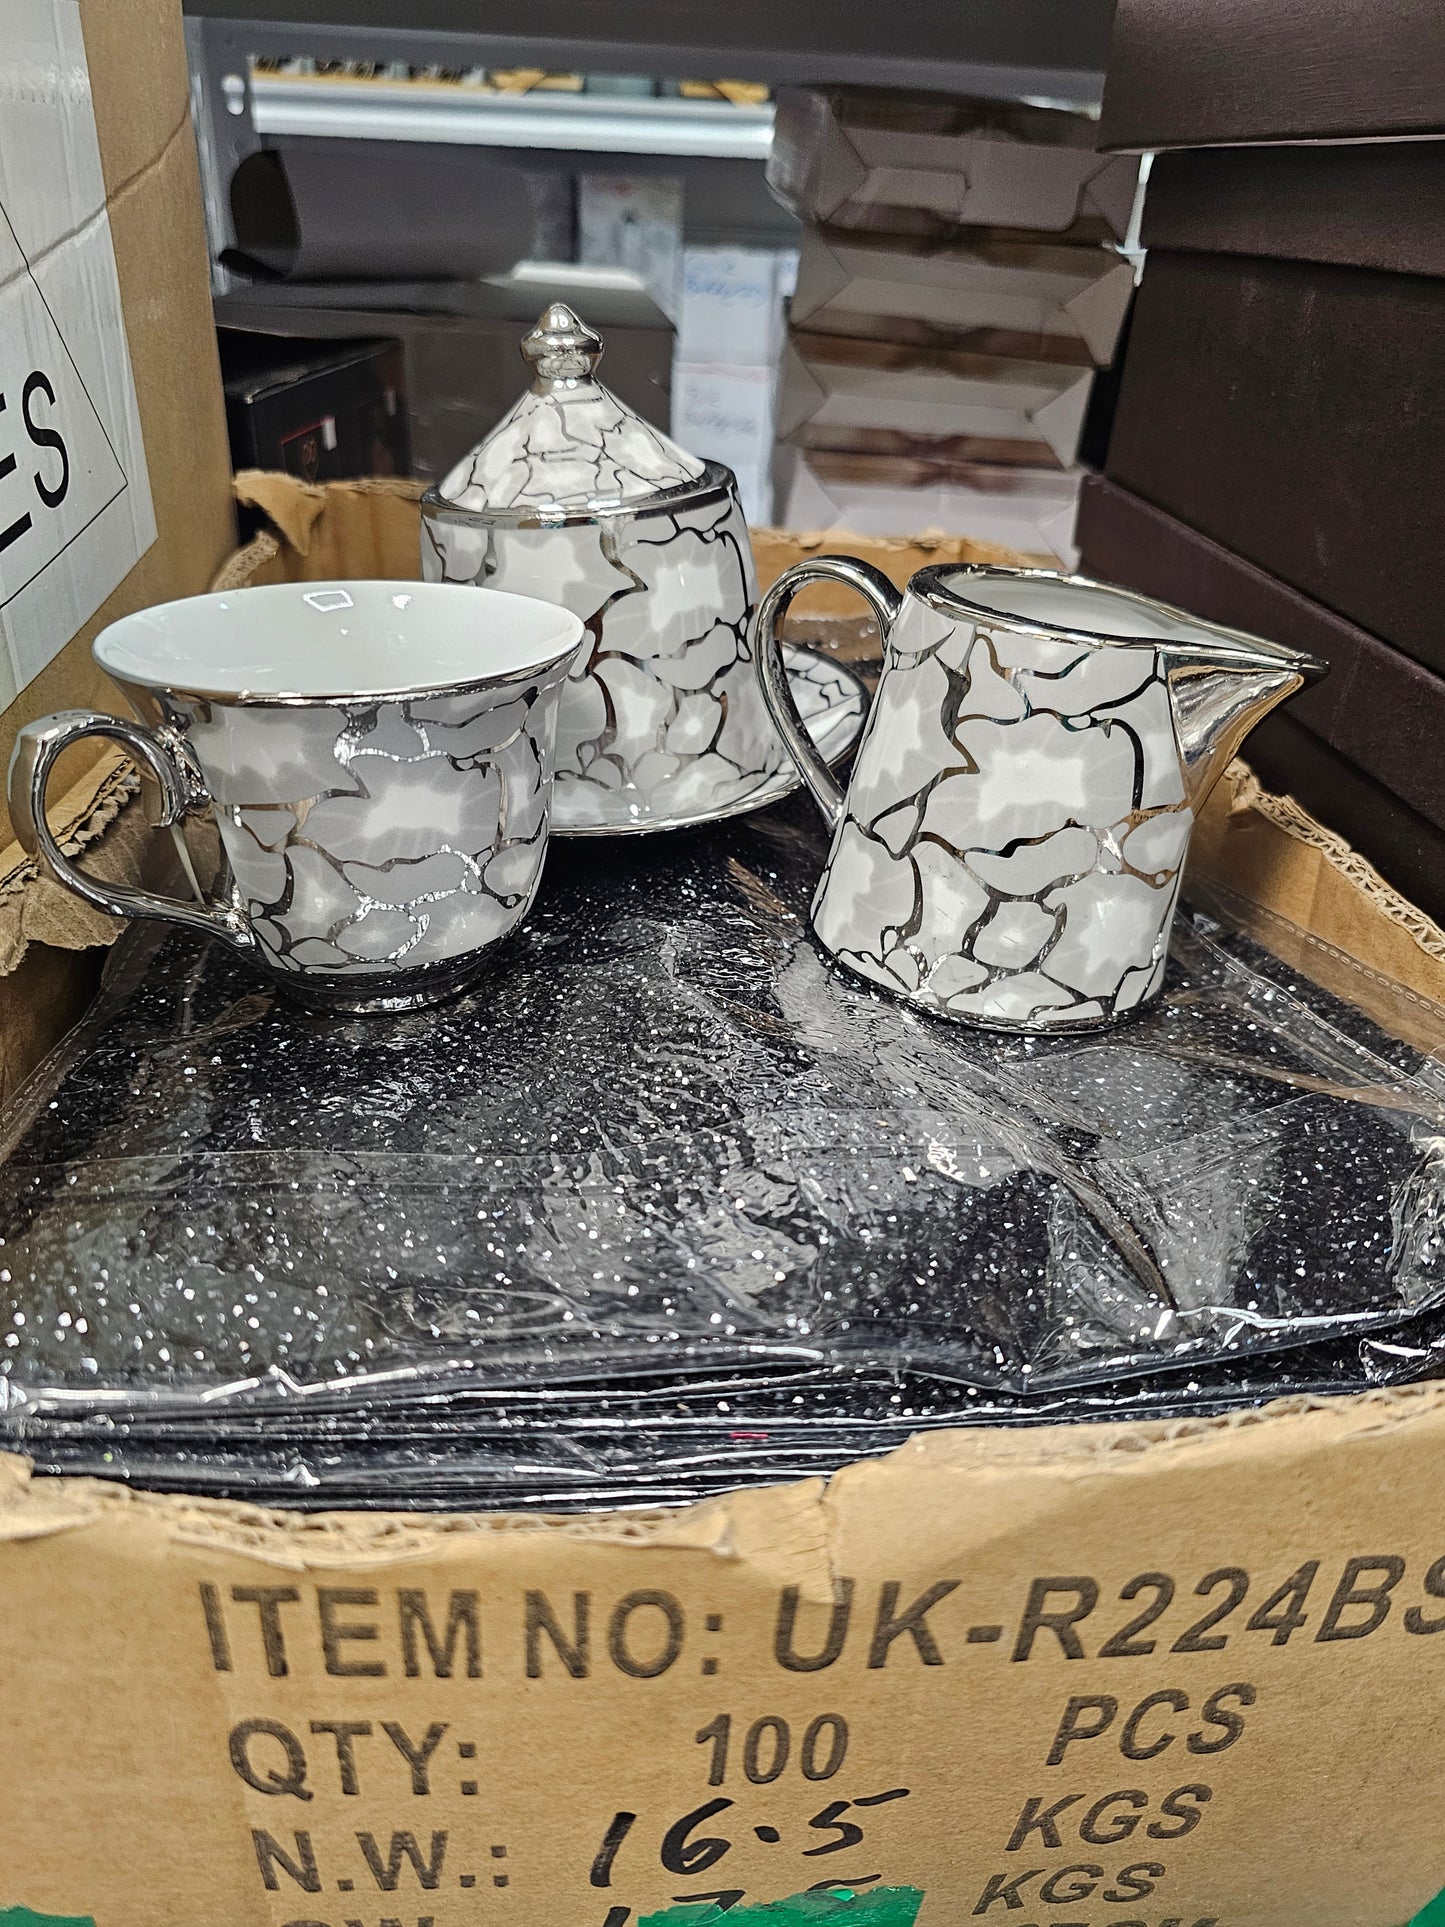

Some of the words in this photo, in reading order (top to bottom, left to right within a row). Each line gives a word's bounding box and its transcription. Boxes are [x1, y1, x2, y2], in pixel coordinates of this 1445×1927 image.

[202, 1582, 482, 1679] ITEM
[527, 1590, 723, 1678] NO:
[229, 1718, 479, 1800] QTY:
[697, 1713, 848, 1786] 100
[1046, 1683, 1257, 1766] PCS
[1006, 1784, 1212, 1851] KGS
[252, 1829, 510, 1891] N.W.:
[972, 1862, 1166, 1915] KGS
